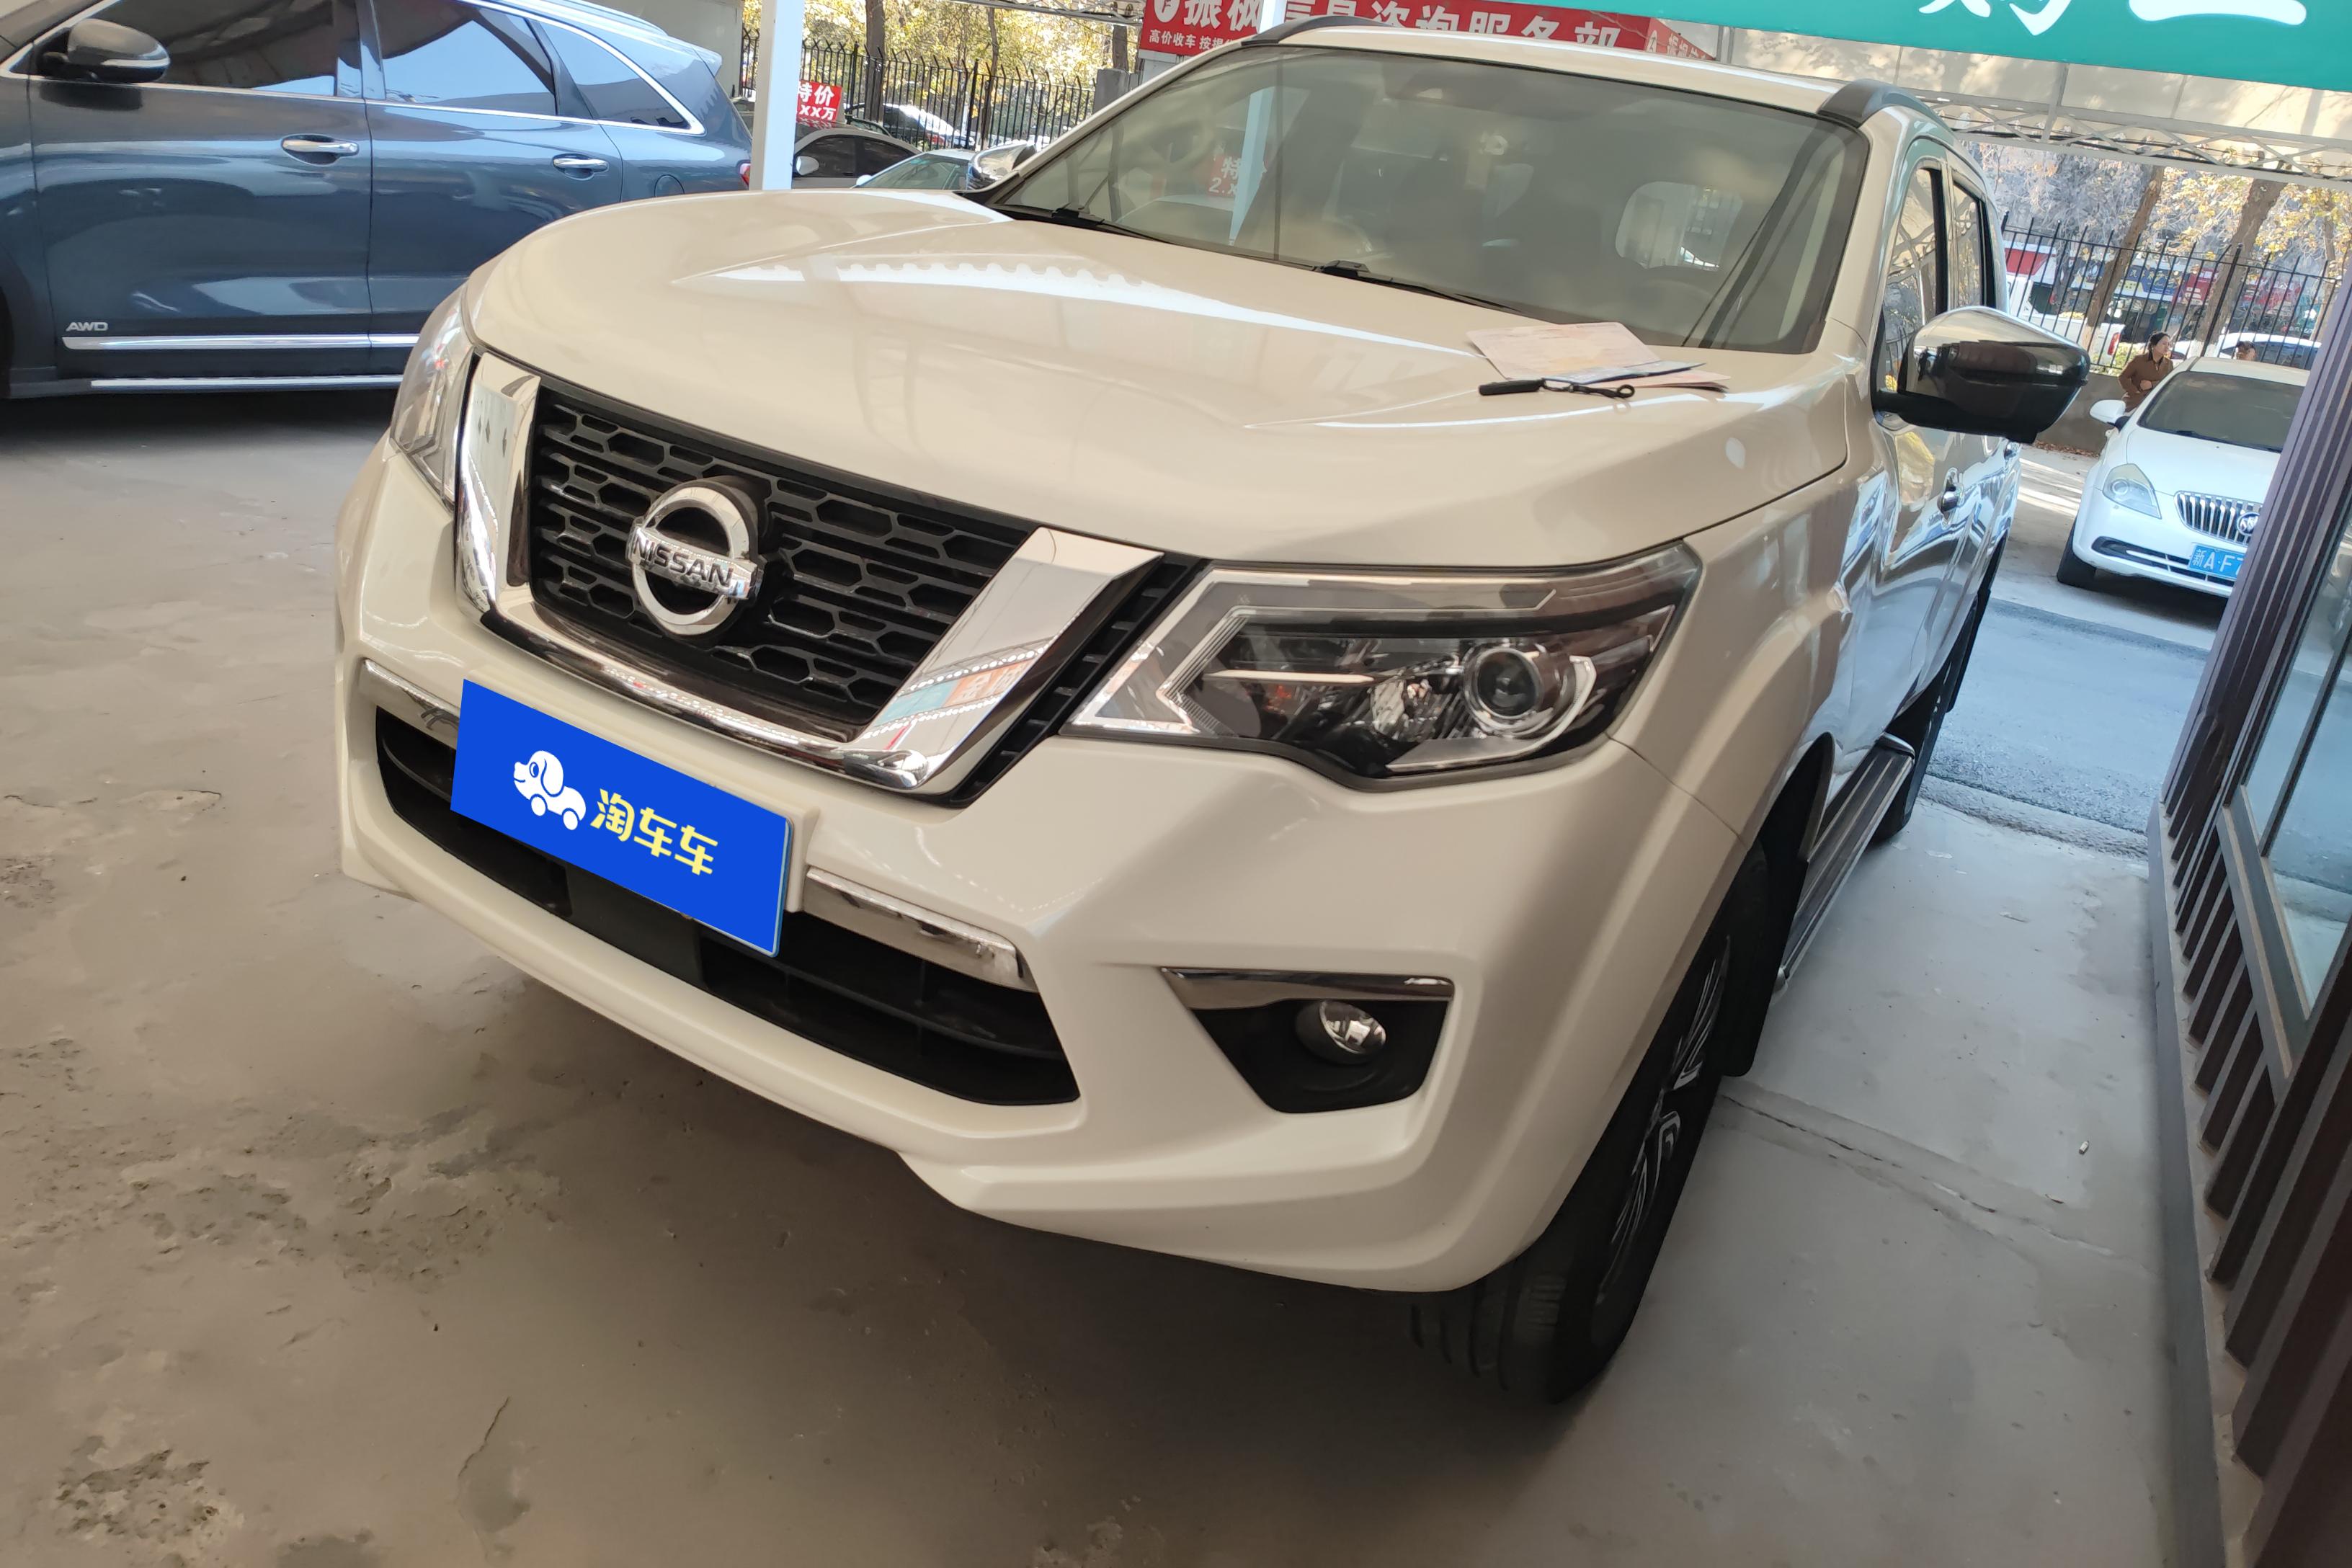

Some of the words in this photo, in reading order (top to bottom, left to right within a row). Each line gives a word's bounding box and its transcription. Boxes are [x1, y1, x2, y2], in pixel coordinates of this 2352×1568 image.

[1149, 29, 1197, 48] 高价收车
[1199, 35, 1234, 50] 按揭
[798, 81, 835, 106] 特价
[66, 321, 109, 331] AWD
[633, 535, 734, 587] NISSAN
